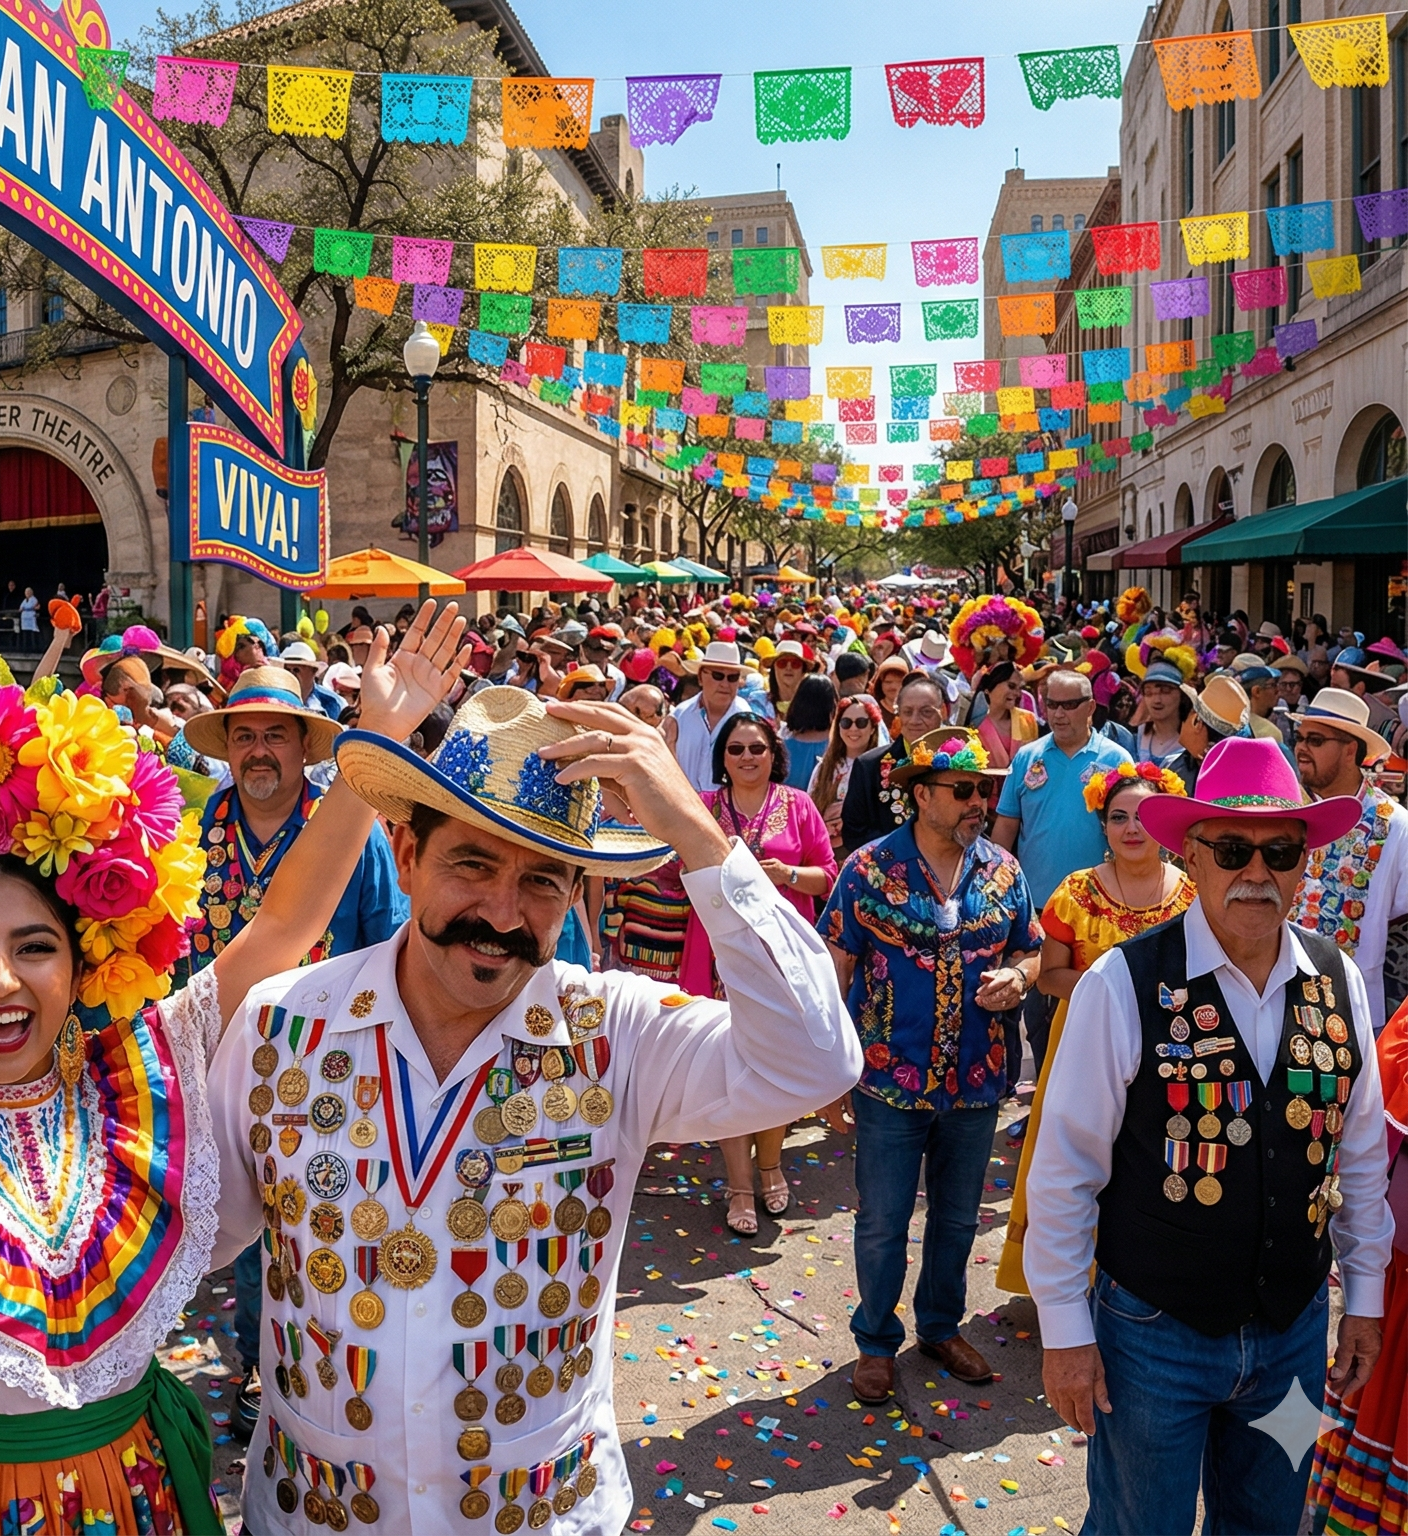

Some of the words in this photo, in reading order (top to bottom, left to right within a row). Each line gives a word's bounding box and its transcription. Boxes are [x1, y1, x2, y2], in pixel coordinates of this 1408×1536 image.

[80, 116, 257, 369] ANTONIO
[31, 408, 116, 486] THEATRE
[214, 457, 300, 562] VIVA!
